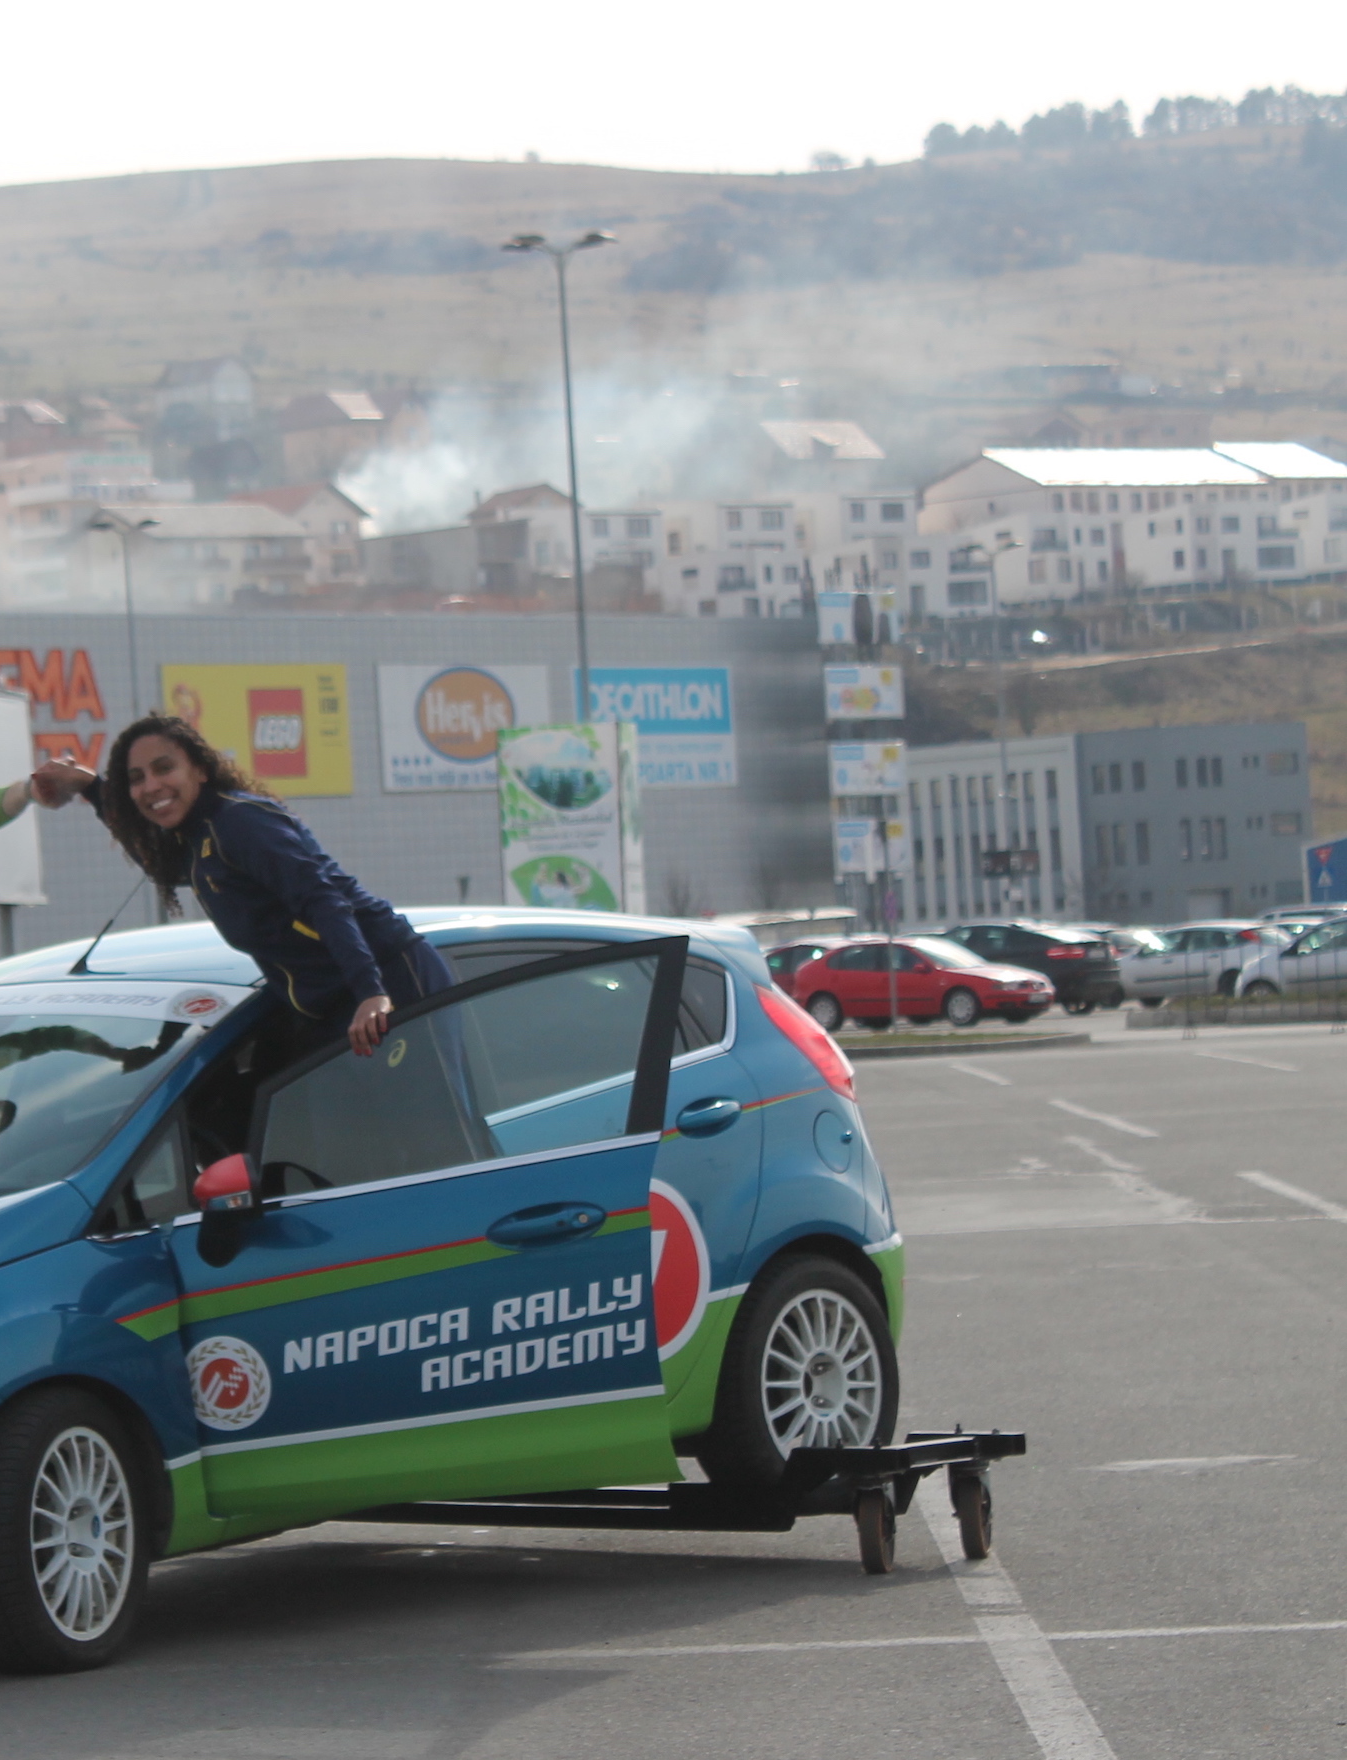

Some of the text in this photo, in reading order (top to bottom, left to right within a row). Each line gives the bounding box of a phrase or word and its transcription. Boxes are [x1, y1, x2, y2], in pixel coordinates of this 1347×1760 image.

[588, 682, 723, 722] DECATHLON
[255, 715, 303, 751] LEGO
[283, 1273, 643, 1374] NAPOCA RALLY
[421, 1318, 647, 1393] ACADEMY
